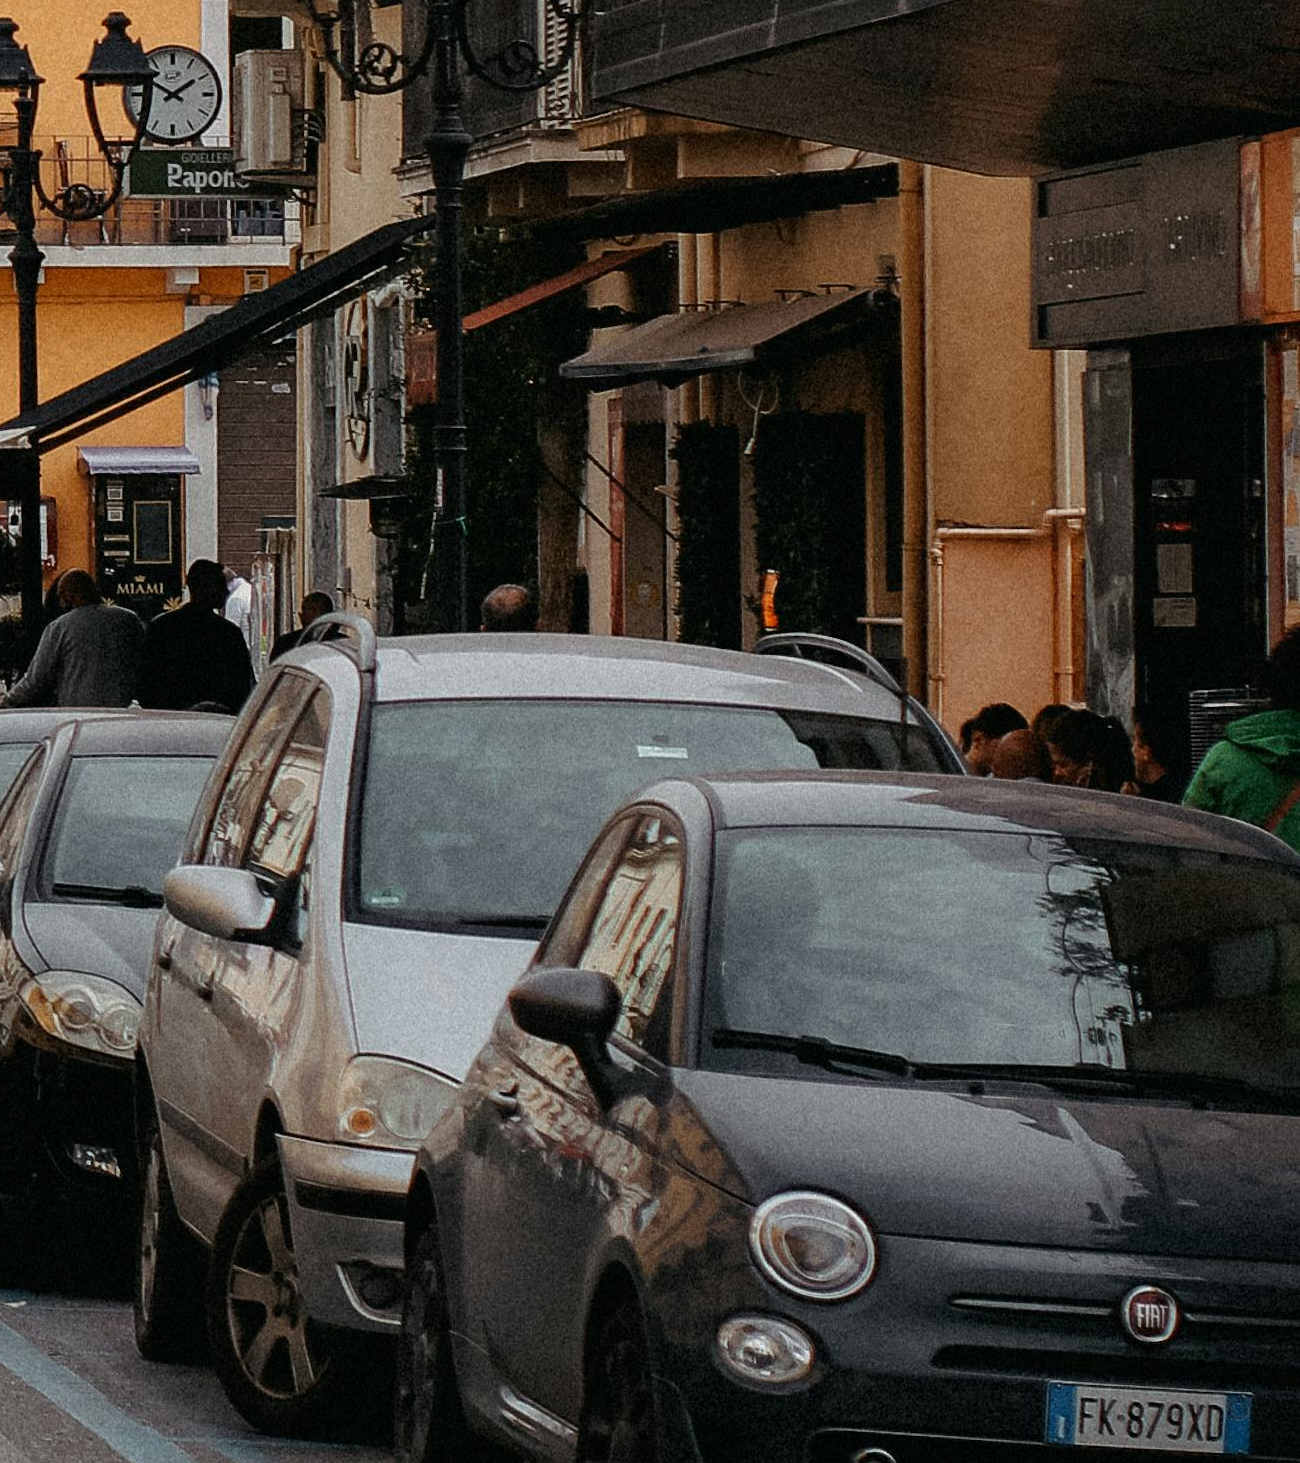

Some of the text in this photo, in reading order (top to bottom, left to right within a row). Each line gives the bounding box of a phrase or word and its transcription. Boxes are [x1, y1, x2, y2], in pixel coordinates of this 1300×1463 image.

[181, 152, 234, 164] GIOIELLERI
[115, 582, 165, 595] MIAMI
[1135, 1302, 1169, 1329] FIAT
